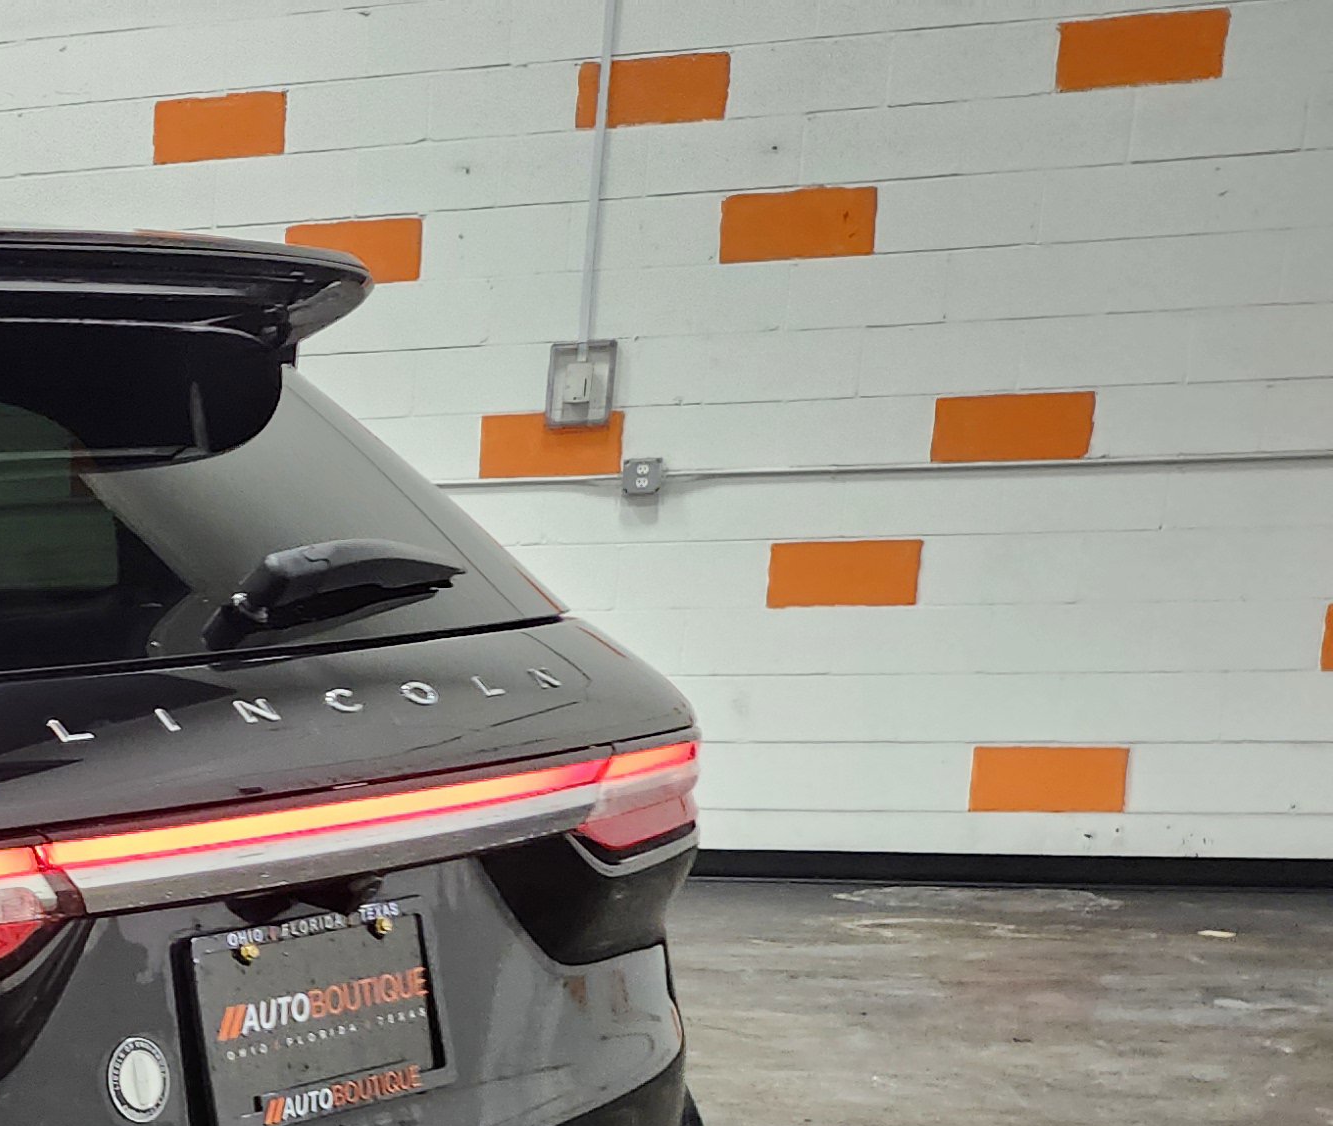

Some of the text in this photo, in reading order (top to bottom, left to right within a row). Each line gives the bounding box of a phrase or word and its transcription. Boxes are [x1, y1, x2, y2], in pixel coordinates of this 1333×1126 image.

[44, 666, 563, 743] LINCOLN
[226, 902, 401, 947] OHIO FLORIDA TEXAS
[240, 966, 429, 1036] AUTOBOUTIQUE
[281, 1064, 423, 1120] AUTOBOUTIQUE
